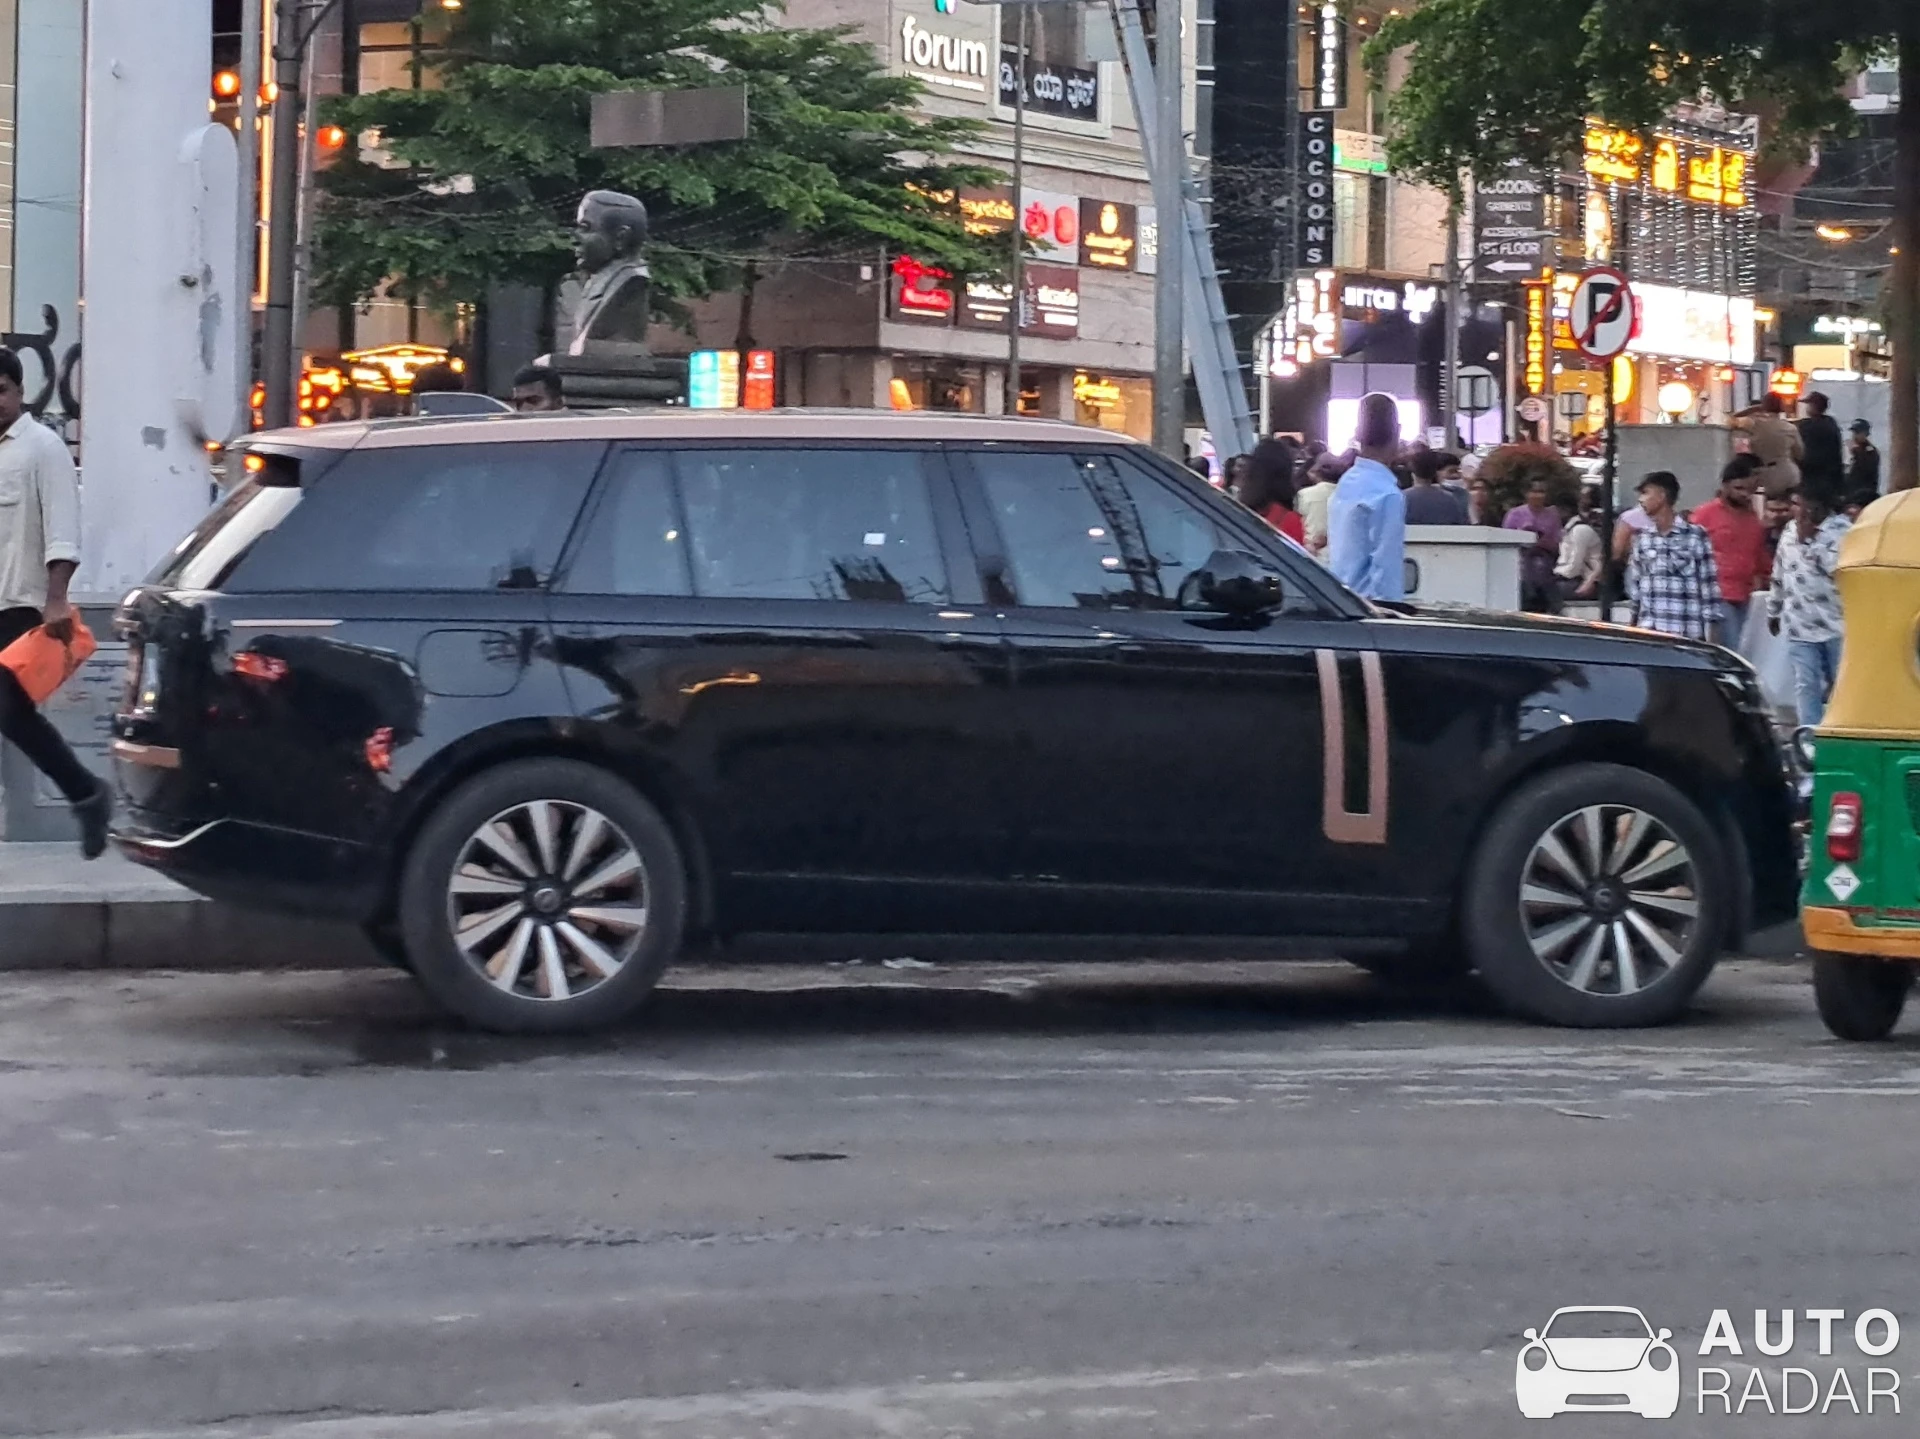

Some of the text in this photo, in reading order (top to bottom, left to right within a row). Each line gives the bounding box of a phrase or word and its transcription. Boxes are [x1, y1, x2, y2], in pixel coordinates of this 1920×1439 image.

[902, 15, 987, 76] forum
[1306, 117, 1326, 264] COCOONS
[1499, 242, 1542, 256] FLOOR
[1587, 282, 1622, 348] P
